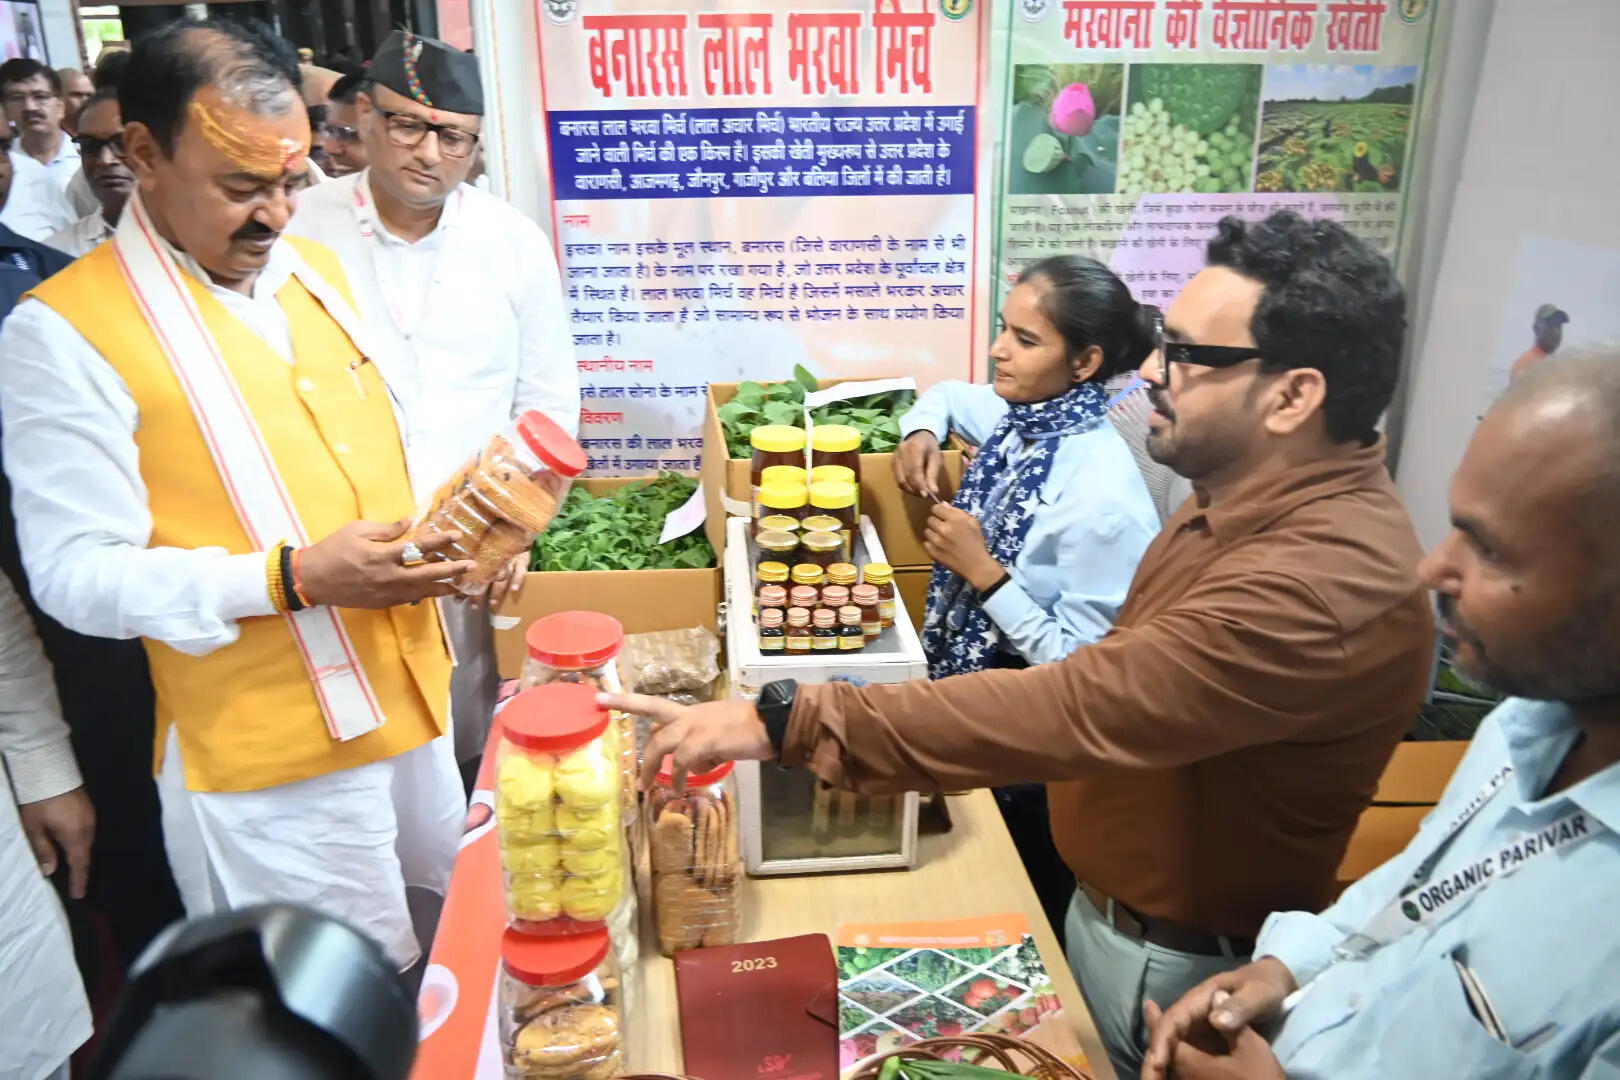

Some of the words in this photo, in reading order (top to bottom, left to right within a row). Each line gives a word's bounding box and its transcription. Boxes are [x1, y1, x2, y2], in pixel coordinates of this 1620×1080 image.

[1062, 0, 1155, 48] मखाना
[1326, 0, 1387, 51] खती
[583, 14, 688, 97] बनारस
[698, 13, 772, 96] लाल
[788, 12, 861, 94] भरवा
[558, 120, 600, 136] बनारस
[601, 120, 628, 136] लाल
[629, 119, 660, 135] भरवा
[662, 113, 687, 135] मिर्च
[689, 117, 720, 135] (लाल
[722, 118, 754, 134] अचार
[756, 111, 785, 134] मिर्च)
[787, 112, 831, 133] भारतीय
[833, 116, 863, 133] राज्य
[865, 116, 891, 132] उत्तर
[893, 111, 921, 132] प्रदेश
[923, 110, 934, 132] में
[936, 109, 965, 135] उगाई
[574, 142, 601, 163] जाने
[602, 141, 630, 162] वाली
[632, 140, 656, 162] मिर्च
[658, 140, 676, 162] की
[677, 146, 698, 162] एक
[700, 139, 731, 161] किस्म
[751, 138, 786, 164] इसकी
[787, 138, 814, 160] खेती
[864, 137, 877, 159] से
[878, 143, 905, 159] उत्तर
[906, 137, 935, 159] प्रदेश
[937, 137, 951, 159] के
[777, 166, 800, 187] और
[802, 165, 839, 187] बलिया
[840, 165, 871, 186] जिलों
[873, 165, 884, 186] में
[885, 164, 903, 185] की
[905, 164, 934, 185] जाती
[563, 215, 590, 228] नाम
[564, 243, 602, 258] इसका
[607, 243, 631, 255] नाम
[635, 238, 668, 256] इसके
[672, 241, 695, 259] मूल
[741, 240, 784, 253] बनारस
[790, 235, 824, 253] (जिसे
[829, 234, 882, 252] वाराणसी
[886, 235, 900, 251] के
[904, 239, 928, 251] नाम
[933, 234, 945, 251] से
[951, 233, 966, 250] भी
[567, 266, 598, 278] जाना
[601, 266, 631, 278] जाता
[653, 261, 668, 277] के
[670, 265, 694, 277] नाम
[697, 265, 715, 276] पर
[718, 265, 743, 276] रखा
[747, 264, 772, 276] गया
[794, 259, 811, 275] जो
[815, 263, 841, 276] उत्तर
[845, 259, 875, 275] प्रदेश
[878, 258, 892, 274] के
[895, 257, 940, 279] पूर्वांचल
[944, 257, 966, 275] क्षेत्र
[568, 285, 578, 300] में
[583, 285, 616, 301] स्थित
[640, 288, 668, 301] लाल
[672, 288, 704, 300] भरवा
[708, 282, 733, 299] मिर्च
[737, 287, 756, 300] वह
[759, 282, 784, 299] मिर्च
[788, 283, 798, 300] है
[802, 282, 840, 298] जिसमें
[844, 282, 881, 298] मसाले
[886, 285, 925, 297] भरकर
[929, 285, 965, 297] अचार
[570, 308, 604, 323] तैयार
[608, 307, 640, 323] किया
[644, 311, 674, 323] जाता
[679, 307, 689, 323] है
[693, 305, 710, 322] जो
[715, 310, 759, 323] सामान्य
[763, 310, 784, 322] रूप
[788, 305, 800, 322] से
[805, 305, 842, 322] भोजन
[846, 304, 859, 320] के
[863, 308, 890, 322] साथ
[894, 304, 928, 320] प्रयोग
[932, 303, 965, 320] किया
[572, 333, 603, 346] जाता
[577, 355, 625, 373] स्थानीय
[628, 360, 653, 373] नाम
[599, 387, 625, 398] लाल
[627, 383, 657, 398] सोना
[659, 383, 671, 398] के
[674, 386, 698, 397] नाम
[580, 407, 624, 425] विवरण
[625, 434, 642, 450] की
[645, 438, 673, 450] लाल
[611, 455, 622, 470] में
[624, 459, 658, 471] उगाया
[661, 459, 690, 470] जाता
[1418, 858, 1494, 912] ORGANIC
[1500, 814, 1588, 870] PARIVAR
[731, 956, 778, 973] 2023
